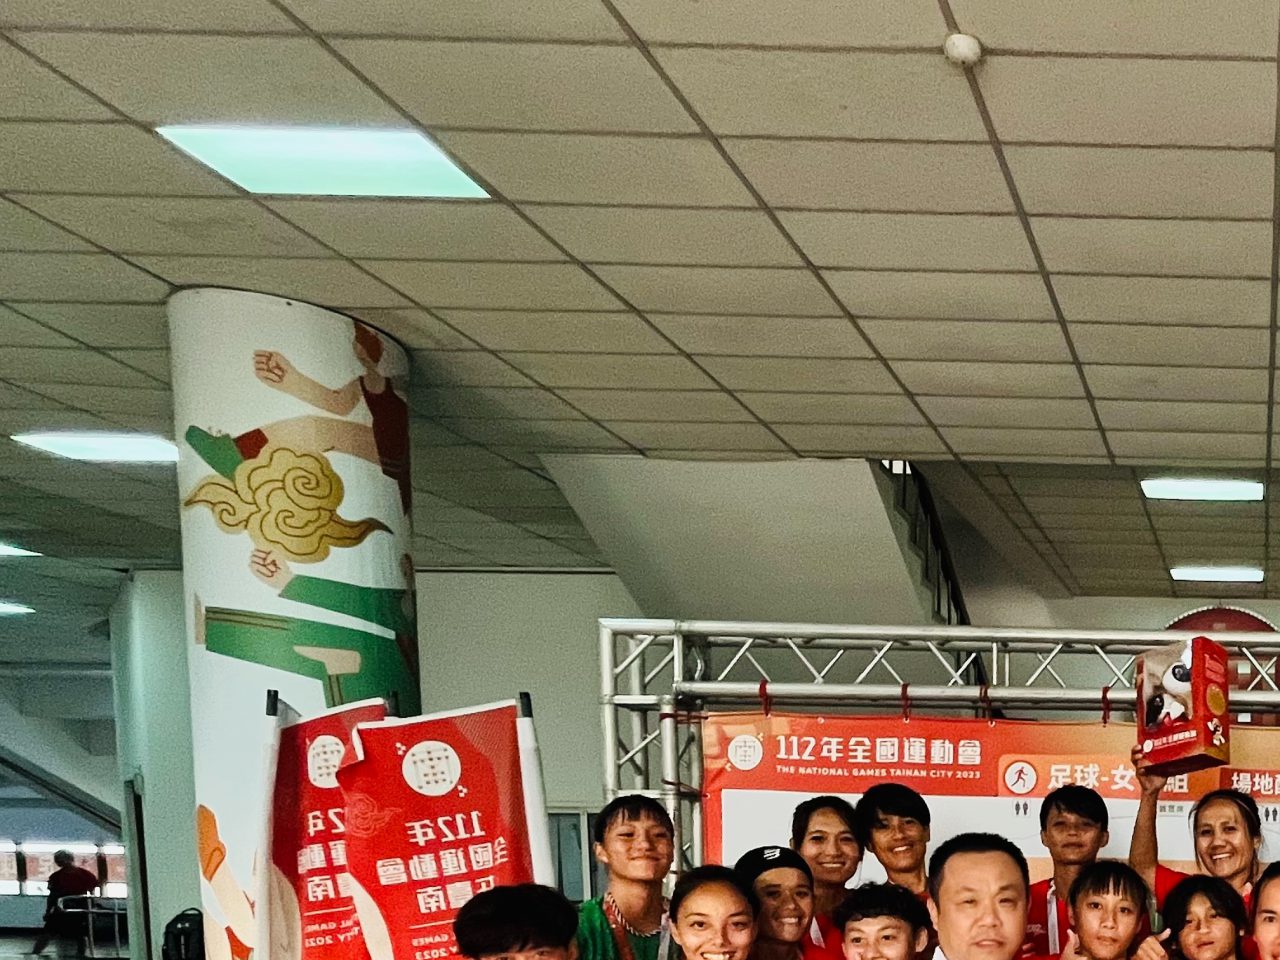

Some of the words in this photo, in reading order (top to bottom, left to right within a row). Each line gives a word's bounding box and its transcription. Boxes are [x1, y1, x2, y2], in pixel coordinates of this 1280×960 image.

[776, 735, 981, 765] 112年全國運動會
[776, 765, 794, 774] THE
[799, 766, 849, 776] NATIONAL
[852, 768, 887, 777] GAMES
[890, 768, 926, 778] TAINAN
[929, 770, 953, 778] CITY
[956, 771, 981, 779] 2023
[1047, 763, 1189, 794] 足球-女組
